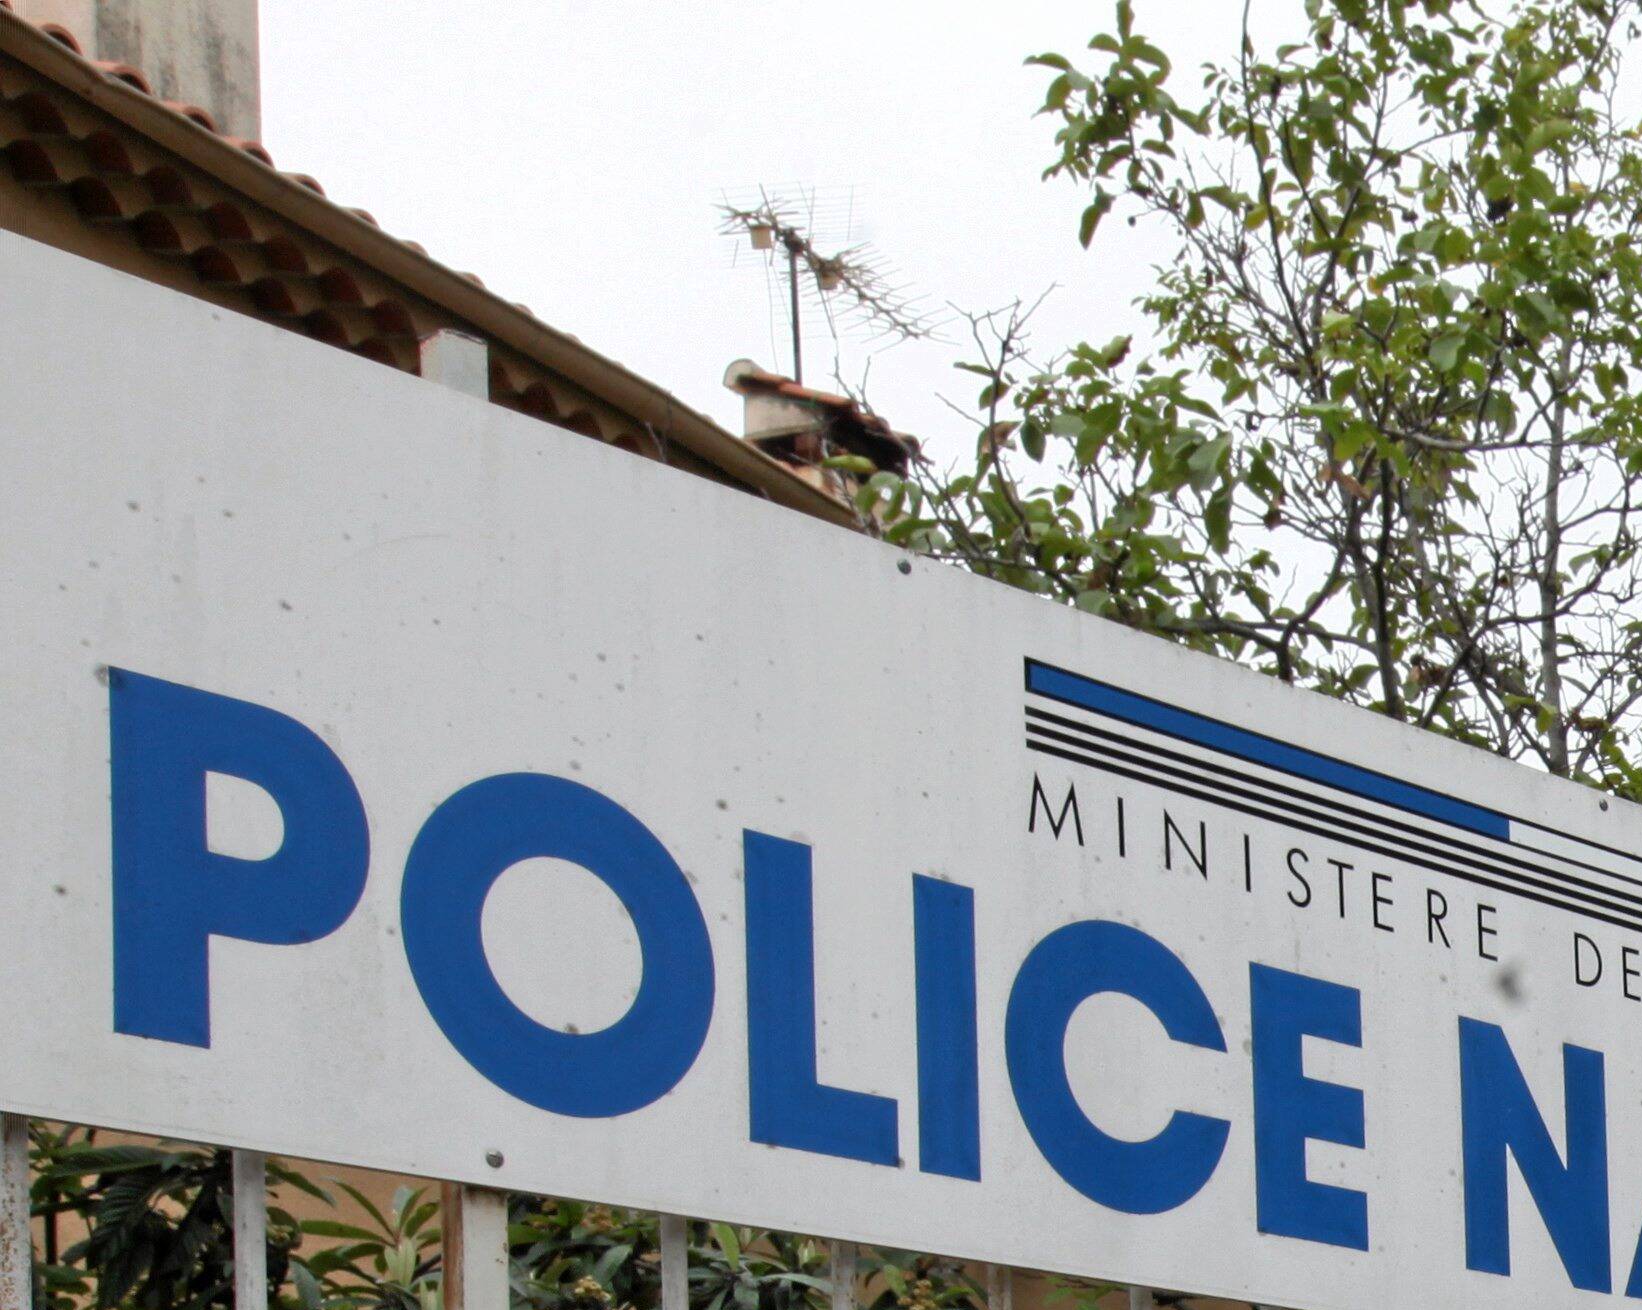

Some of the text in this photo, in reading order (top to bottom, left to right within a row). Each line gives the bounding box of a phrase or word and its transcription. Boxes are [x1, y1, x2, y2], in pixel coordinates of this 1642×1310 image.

[108, 665, 1370, 1252] POLICE
[1028, 772, 1499, 962] MINISTERE
[1572, 932, 1642, 1002] DE
